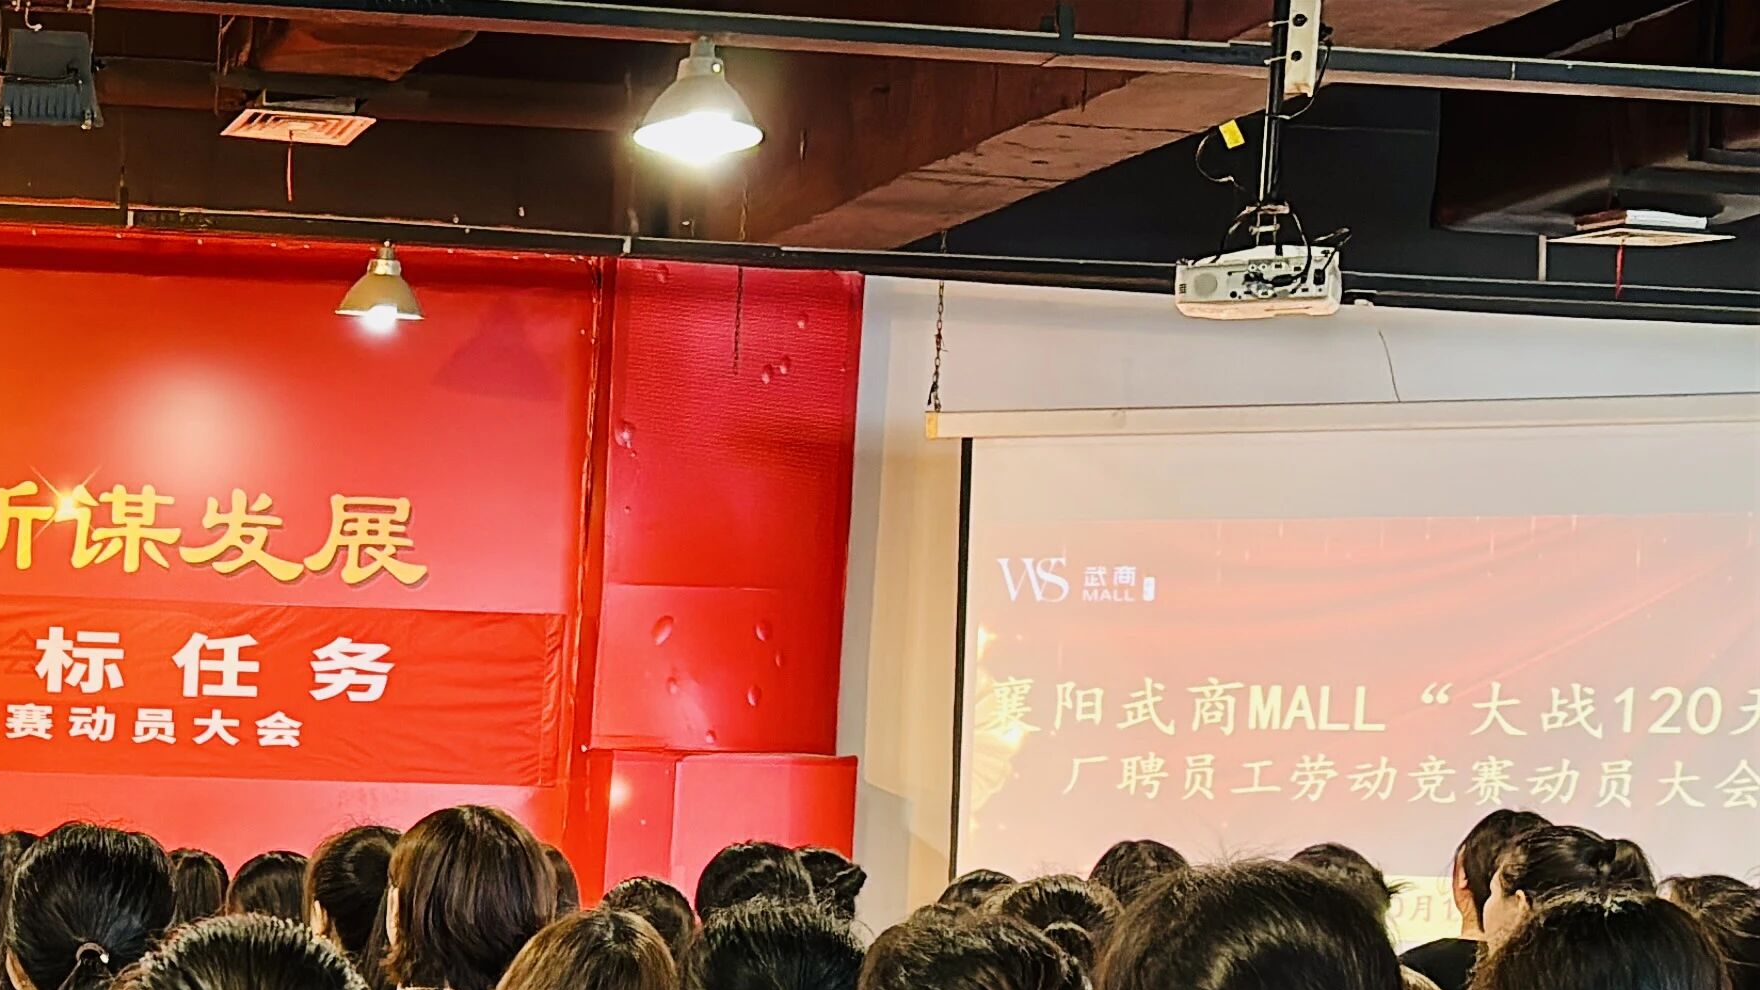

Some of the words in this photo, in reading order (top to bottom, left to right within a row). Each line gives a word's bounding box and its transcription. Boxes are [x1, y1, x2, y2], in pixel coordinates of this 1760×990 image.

[1083, 565, 1137, 588] 武商
[1082, 588, 1136, 602] MALL
[988, 675, 1386, 735] 襄阳武商MALL
